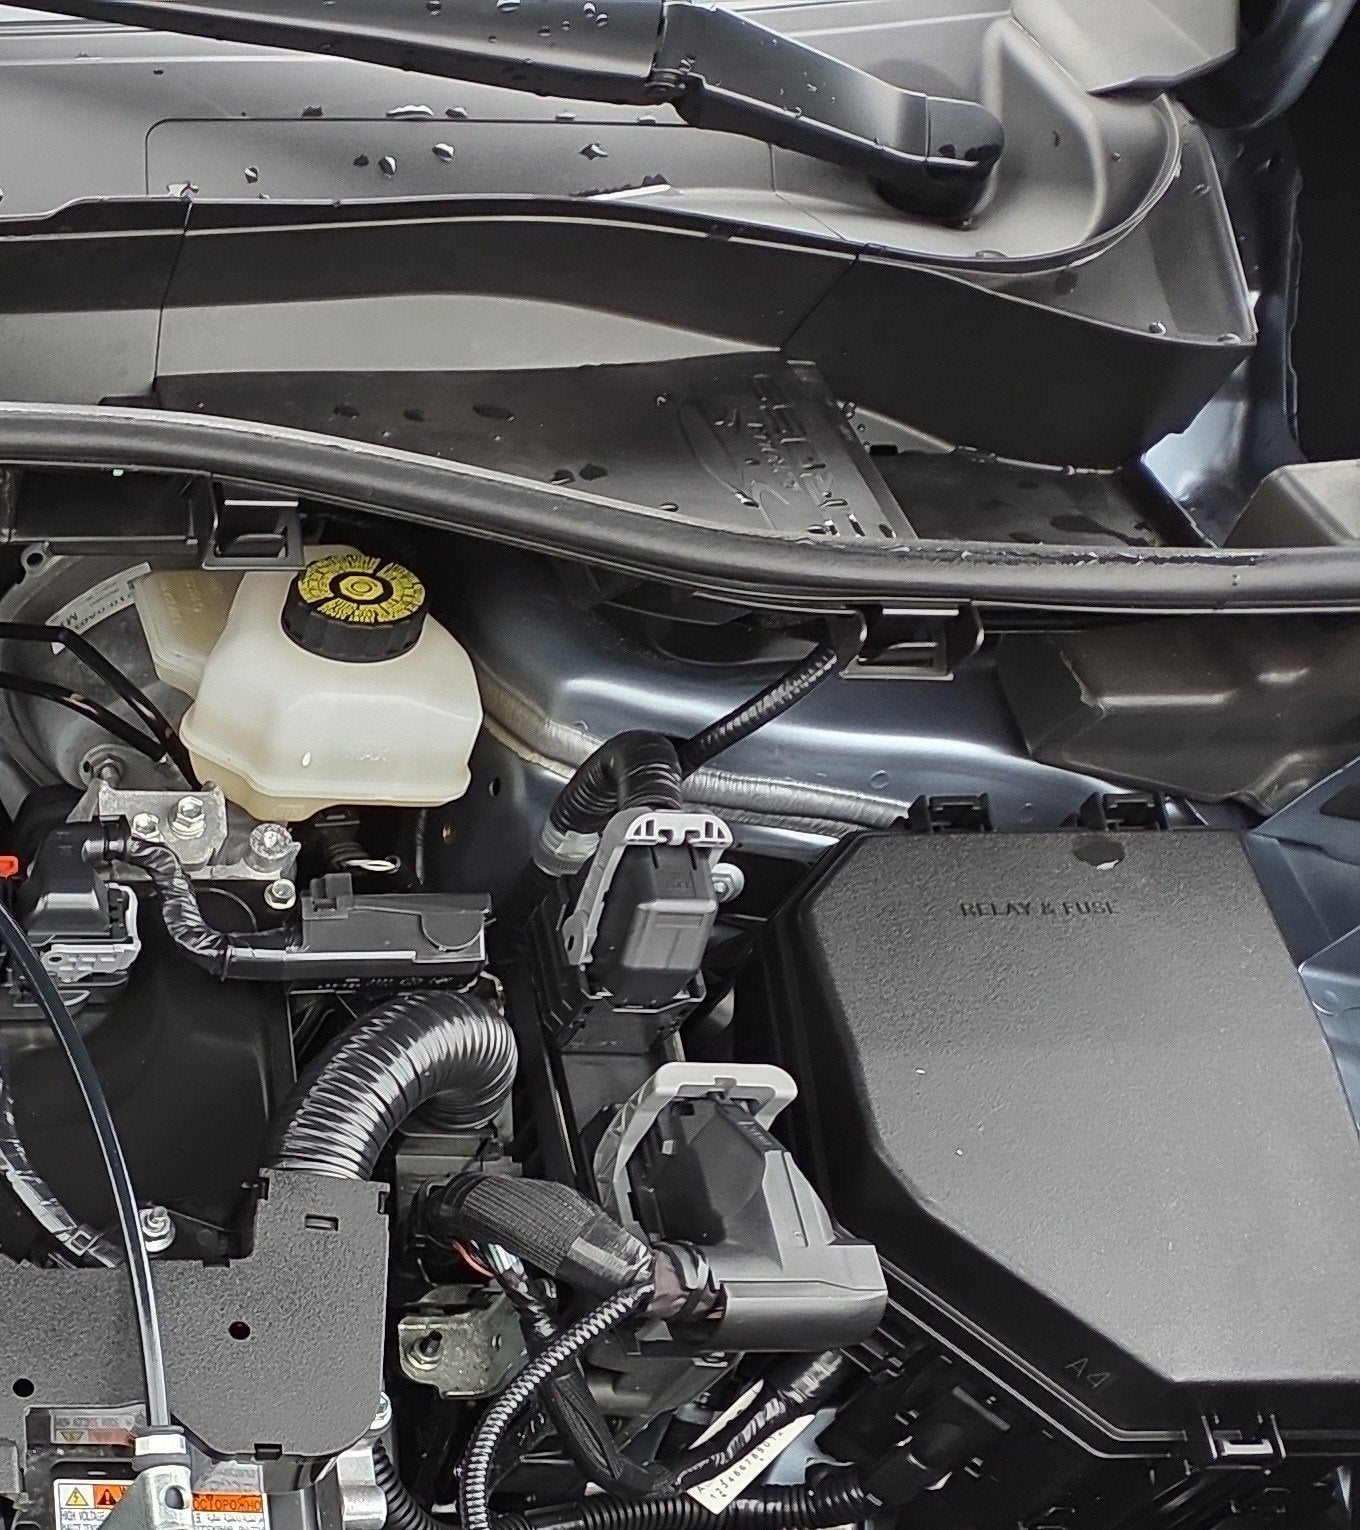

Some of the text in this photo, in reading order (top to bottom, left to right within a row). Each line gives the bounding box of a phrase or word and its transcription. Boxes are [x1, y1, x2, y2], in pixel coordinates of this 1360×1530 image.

[960, 901, 1121, 917] RELAY & FUSE
